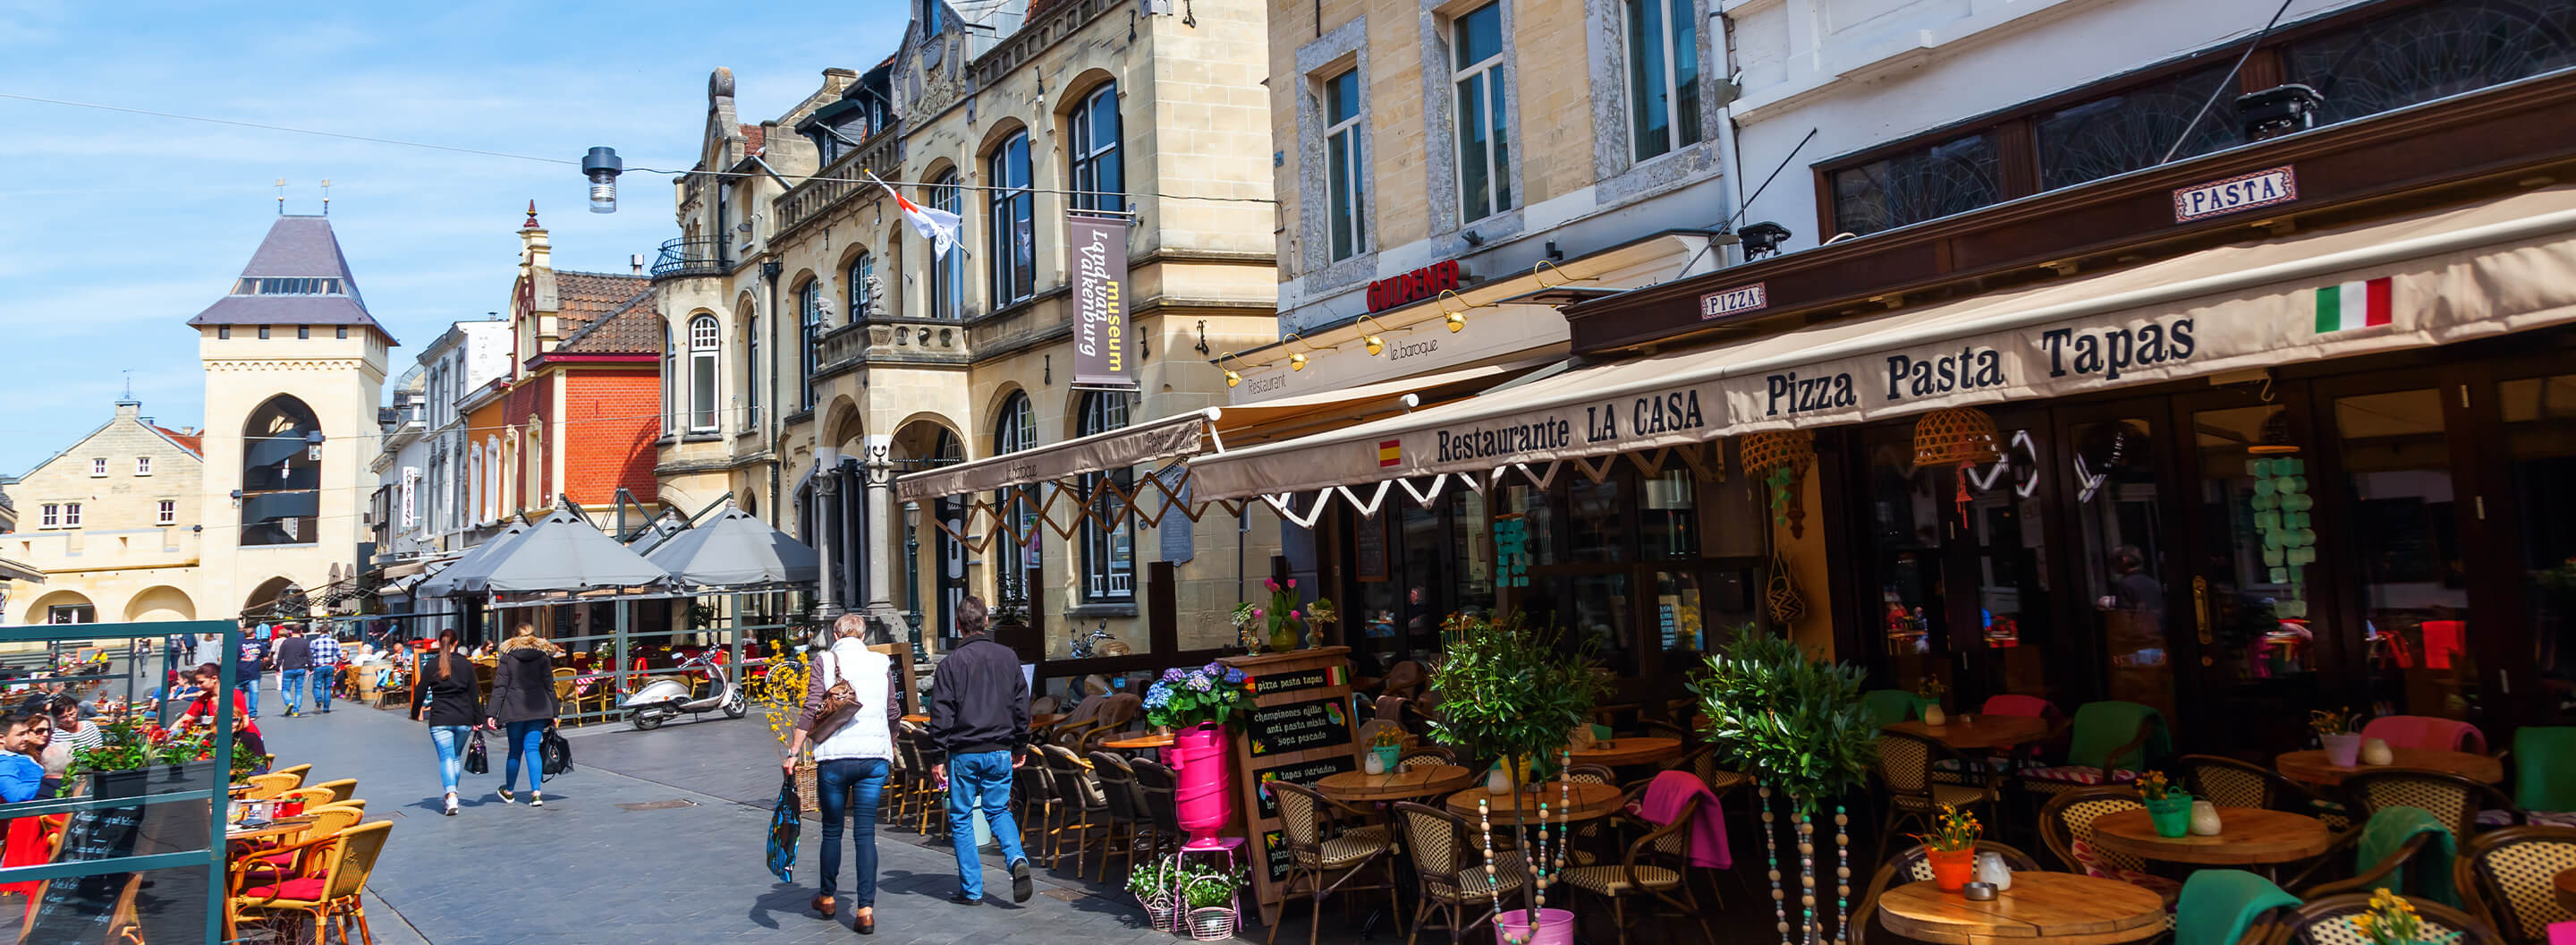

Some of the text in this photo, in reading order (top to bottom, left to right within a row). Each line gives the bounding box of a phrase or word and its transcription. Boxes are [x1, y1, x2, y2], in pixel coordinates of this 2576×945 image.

[2190, 177, 2276, 213] PASTA
[1092, 229, 1111, 322] Land van
[1367, 259, 1460, 313] GULPENER
[1079, 245, 1098, 358] Valkenburg
[1709, 289, 1756, 313] PIZZA
[1106, 280, 1122, 372] museum
[1389, 337, 1438, 361] le baroque
[1767, 318, 2195, 417] Pizza Pasta Tapas
[1248, 373, 1286, 396] Restaurant
[1437, 389, 1705, 463] Restaurante LA CASA
[1258, 675, 1324, 693] pizza pasta tapas
[1267, 723, 1283, 734] anti
[1284, 721, 1305, 733] pasta
[1277, 731, 1326, 746] sopa pescado
[1281, 764, 1337, 780] tapas variadas
